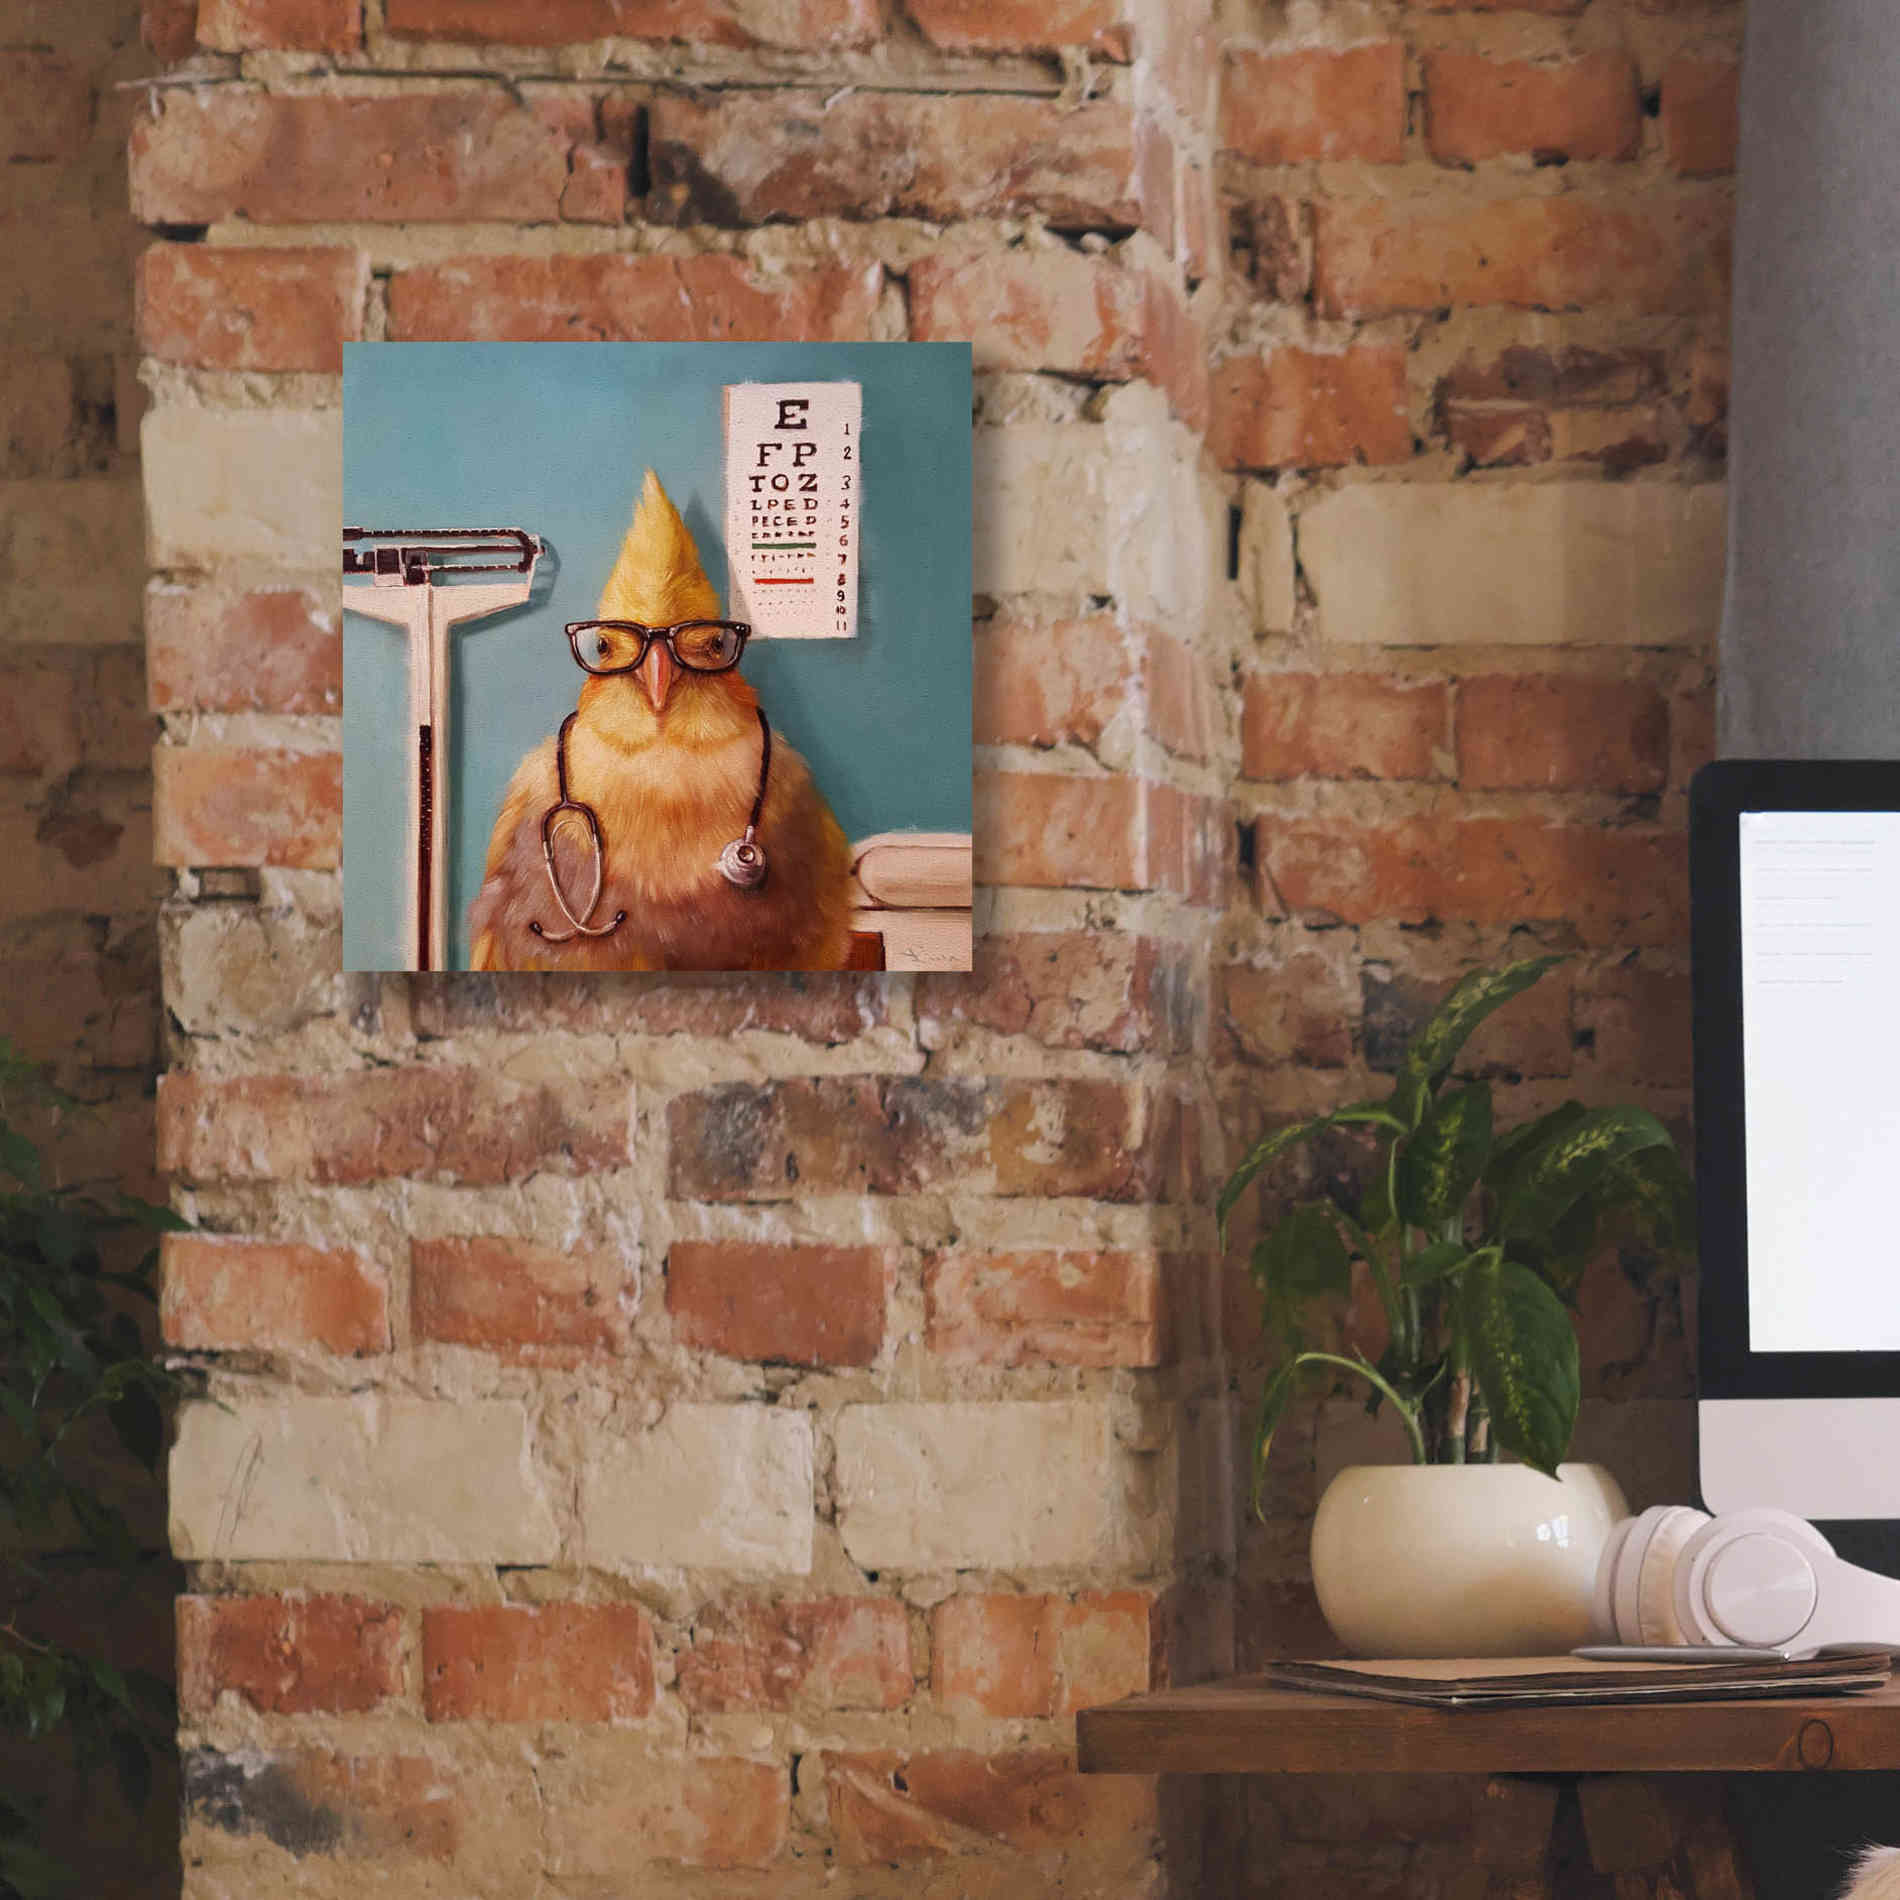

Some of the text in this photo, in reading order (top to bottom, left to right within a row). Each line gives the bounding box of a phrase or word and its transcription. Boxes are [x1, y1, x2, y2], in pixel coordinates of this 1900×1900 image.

[774, 399, 809, 430] E
[843, 446, 852, 460] 2
[840, 475, 852, 490] 3
[839, 499, 850, 510] 4
[841, 515, 850, 529] 5
[839, 534, 848, 547] 6
[837, 553, 847, 566] 7
[837, 573, 846, 586] 8
[836, 590, 845, 602] 9
[836, 606, 846, 615] 10
